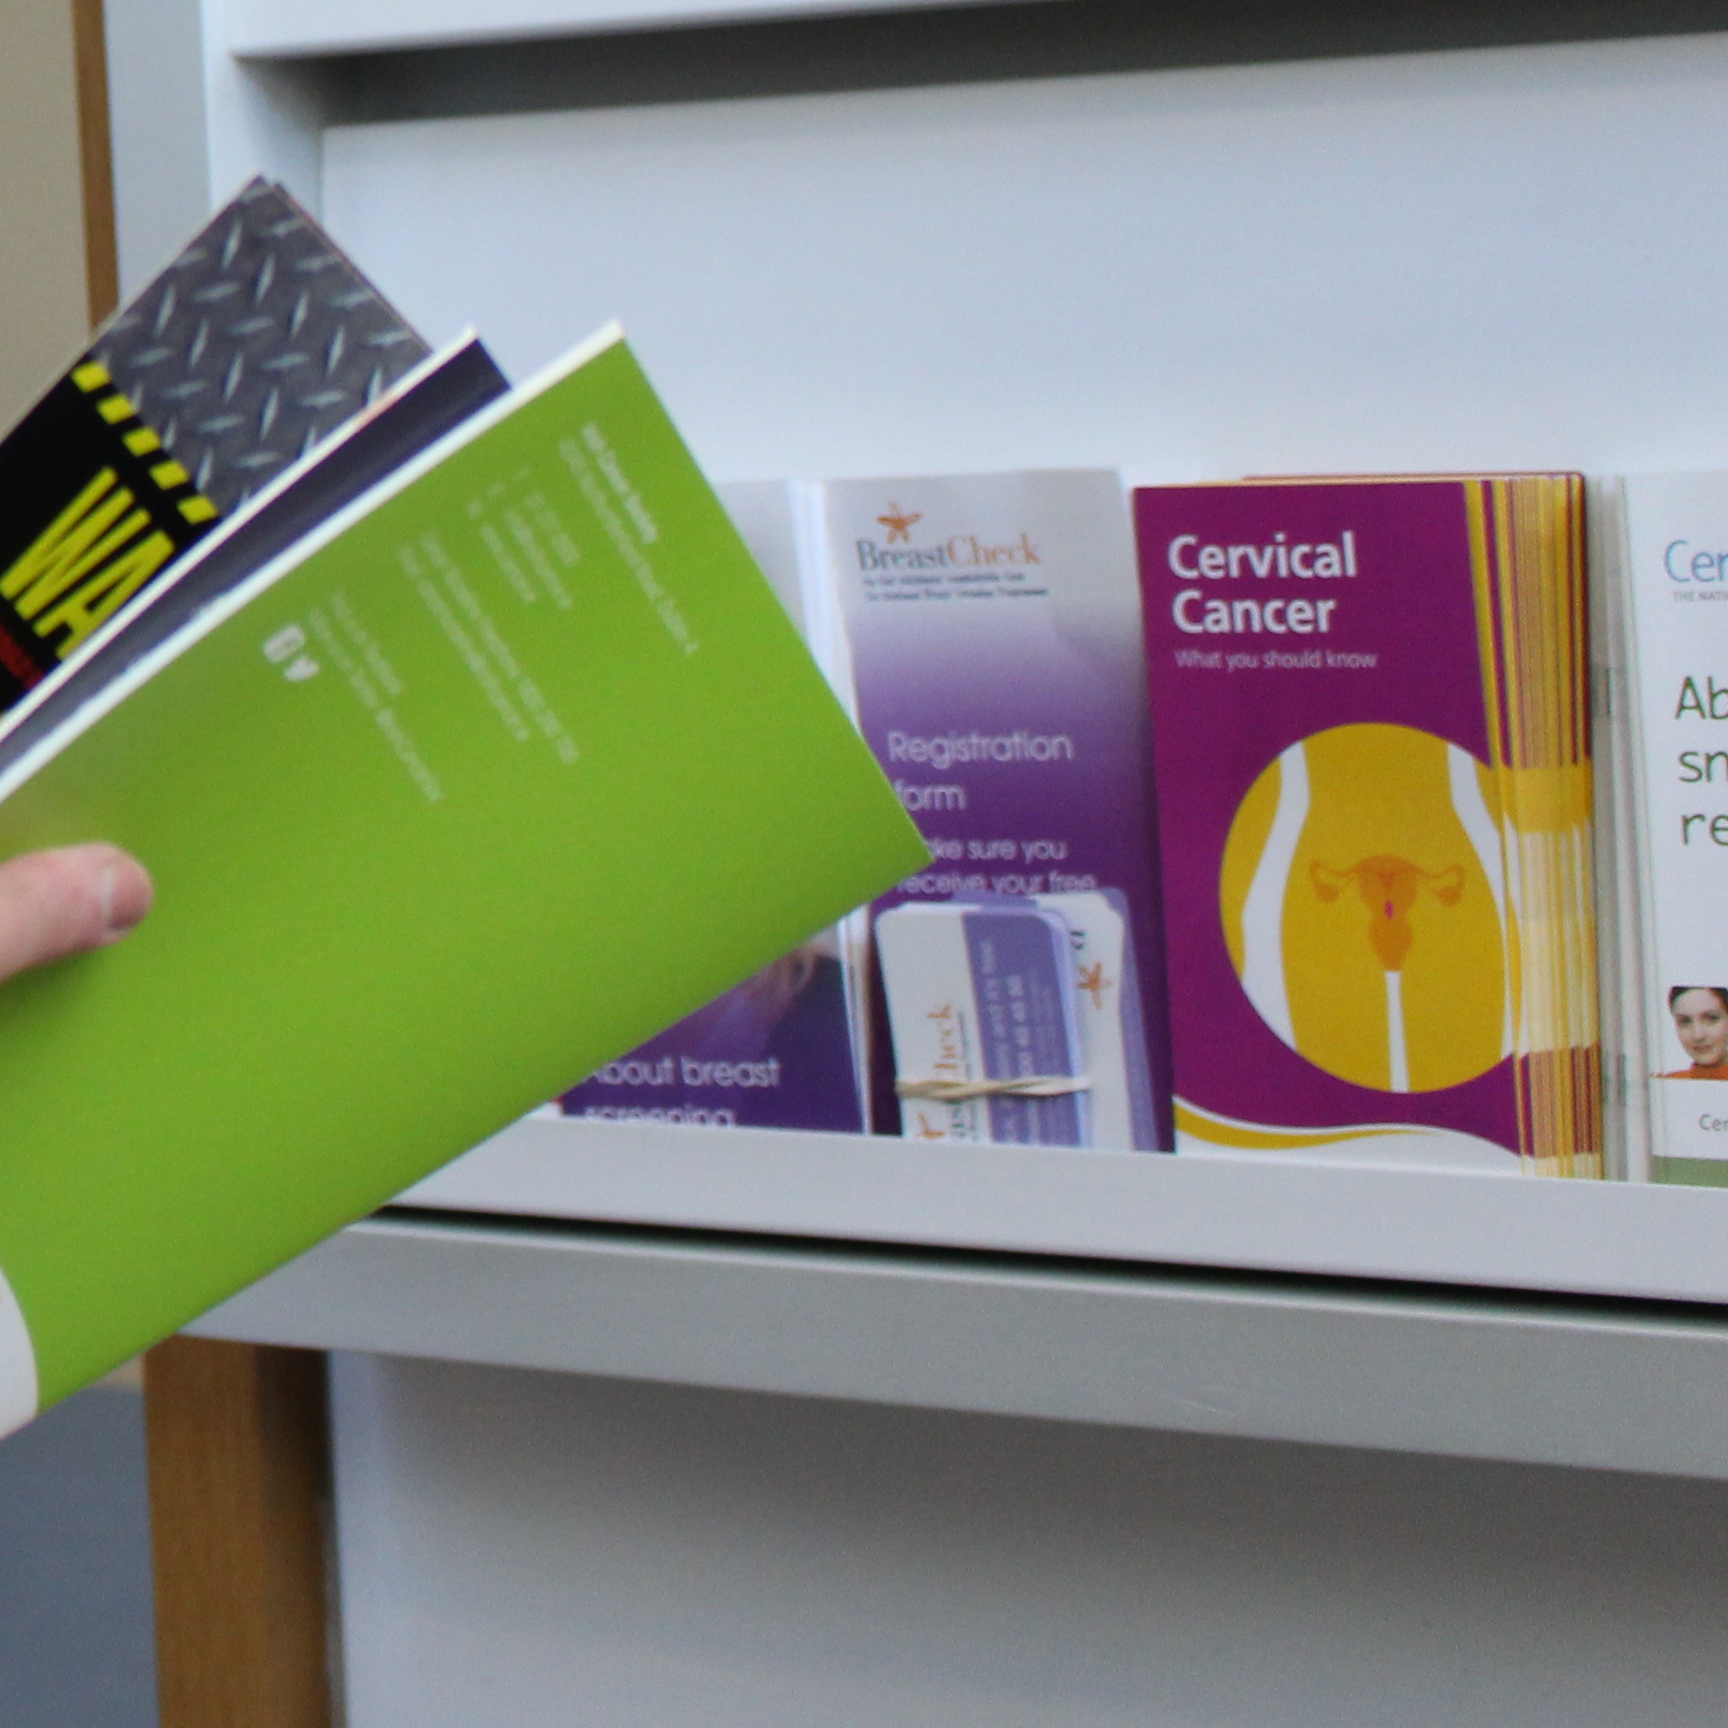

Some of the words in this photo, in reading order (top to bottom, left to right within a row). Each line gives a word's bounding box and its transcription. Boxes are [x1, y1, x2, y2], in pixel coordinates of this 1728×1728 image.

[1168, 530, 1358, 579] Cervical
[1172, 588, 1337, 634] Cancer
[1174, 649, 1222, 669] What
[1226, 652, 1259, 672] you
[1262, 649, 1322, 669] should
[1326, 649, 1378, 669] know
[888, 730, 1074, 770] Registration
[967, 840, 1017, 860] sure
[1020, 840, 1069, 864] you
[680, 1056, 781, 1088] breast
